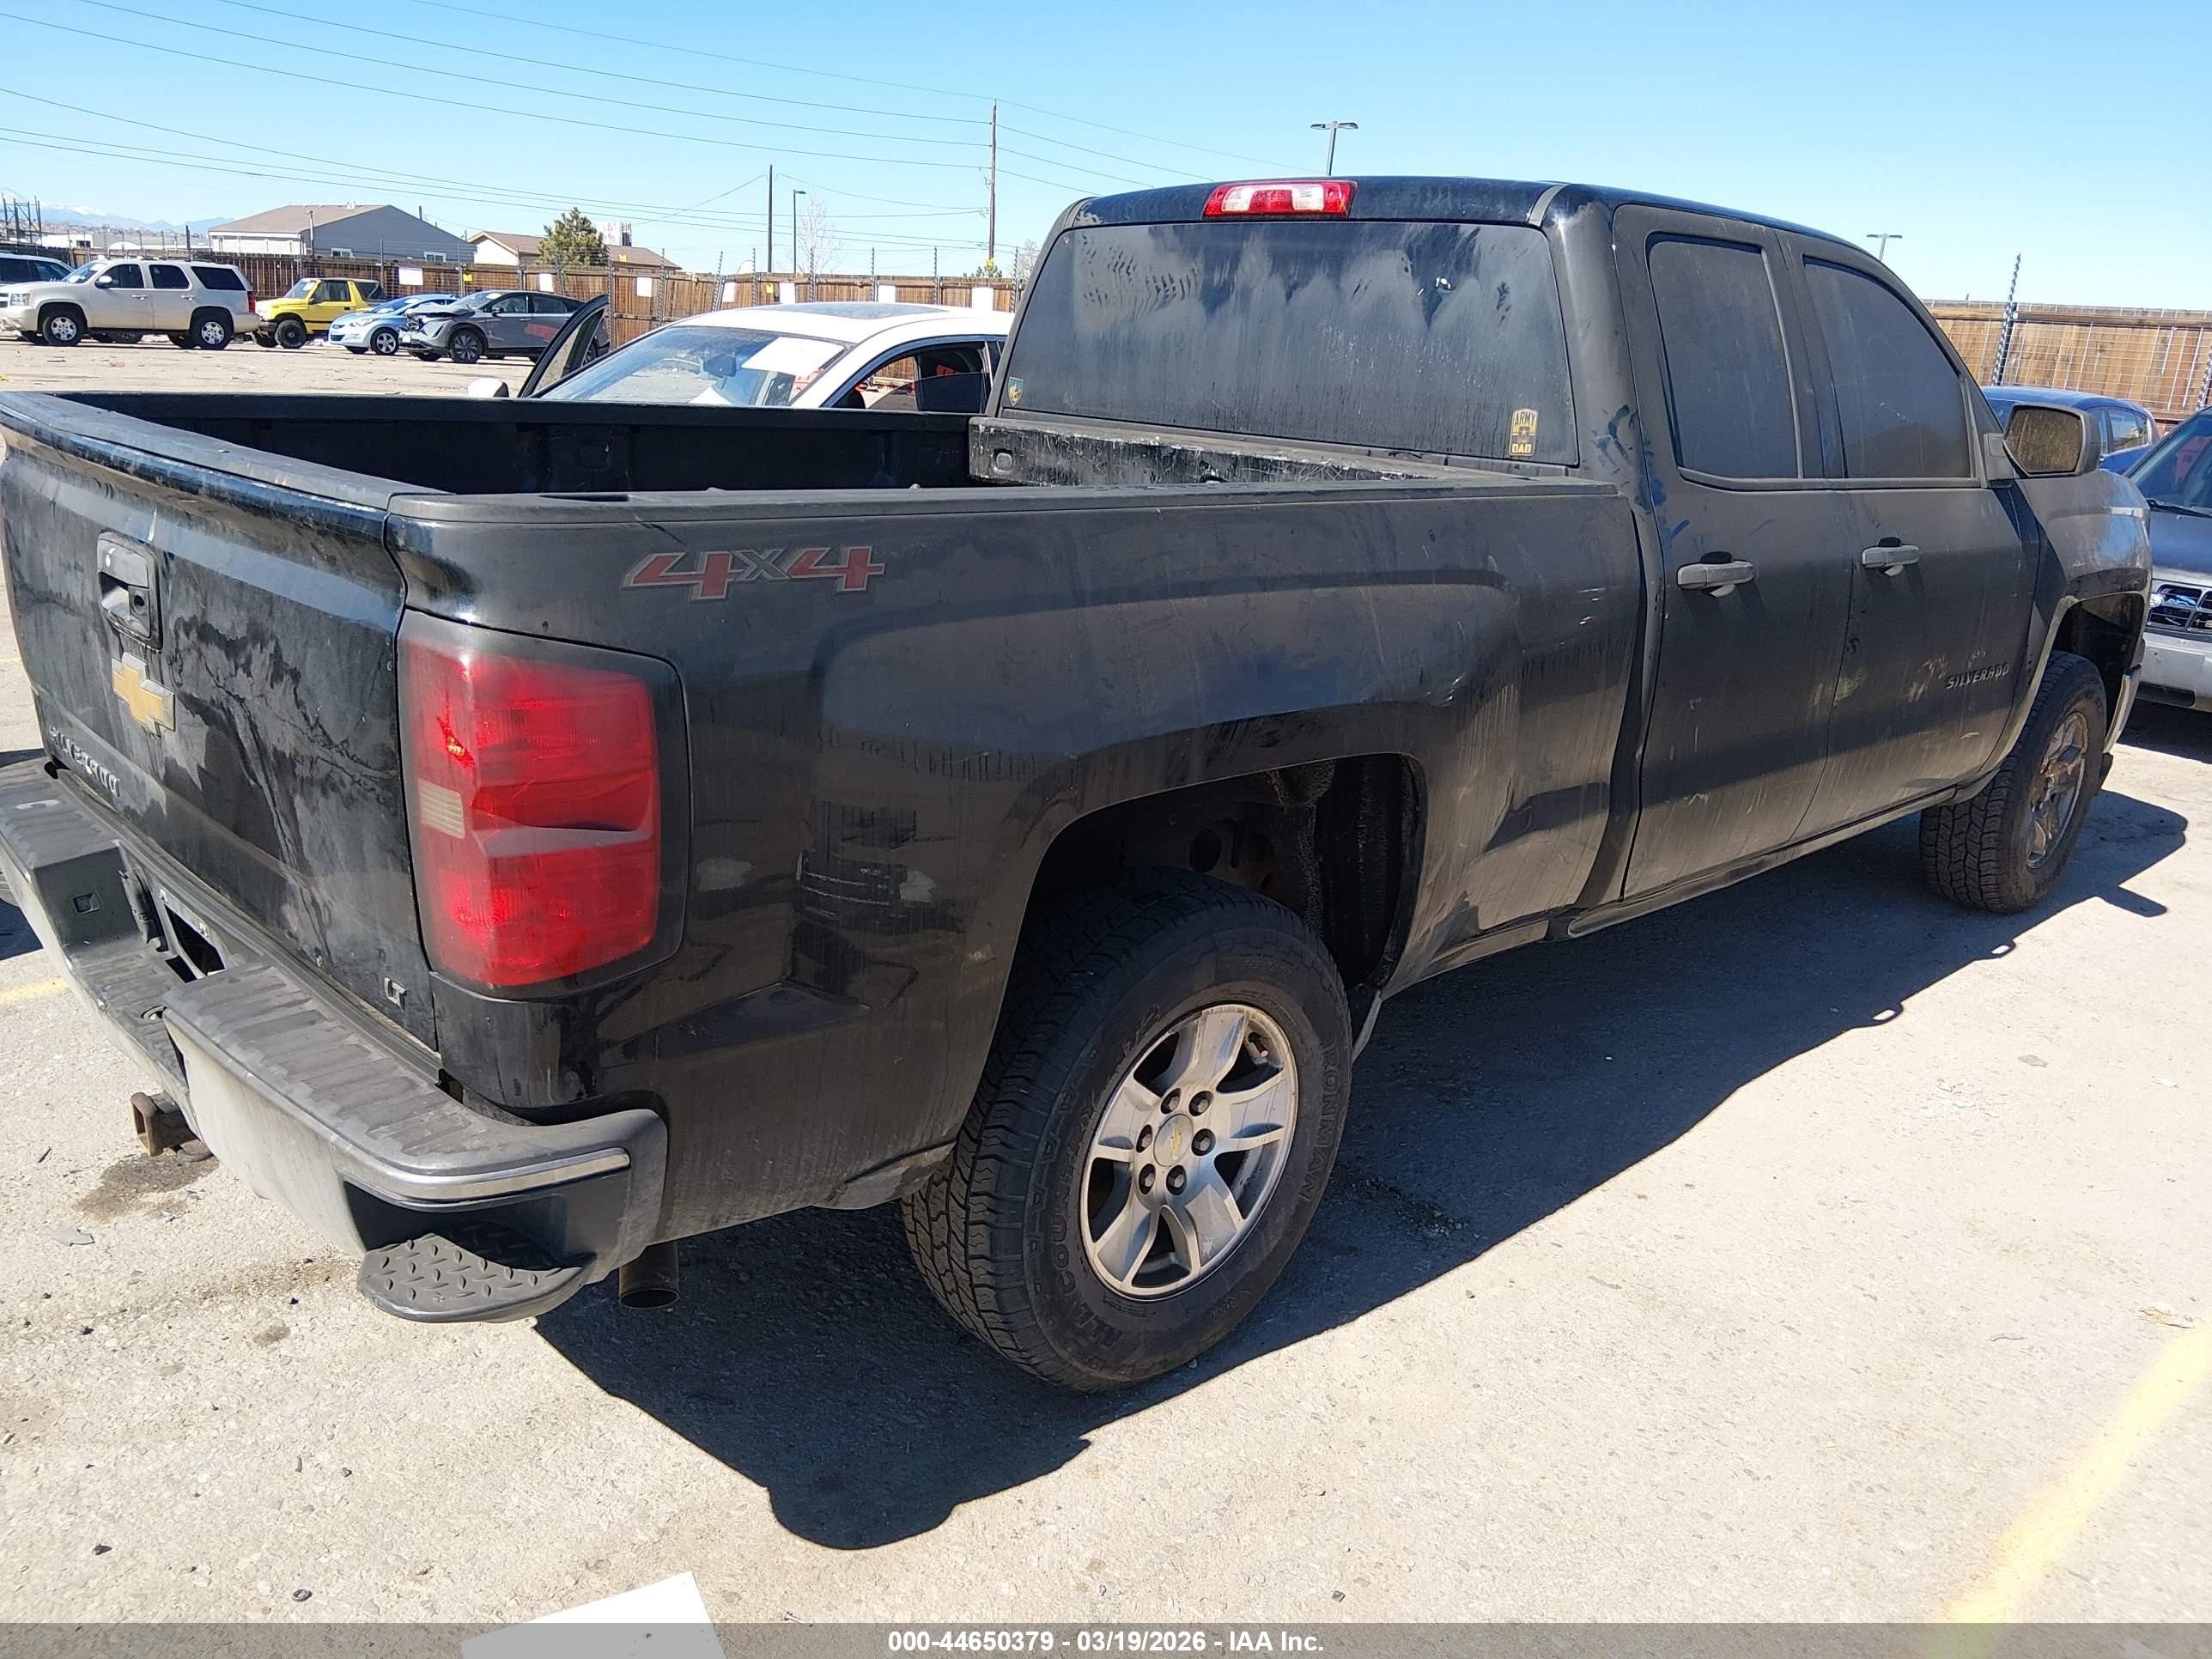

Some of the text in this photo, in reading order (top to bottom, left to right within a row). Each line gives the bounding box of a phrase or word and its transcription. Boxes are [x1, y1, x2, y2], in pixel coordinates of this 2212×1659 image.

[1513, 412, 1536, 427] ARMY
[1511, 443, 1532, 453] DAD
[1944, 662, 2010, 690] SILVERADO
[384, 976, 406, 1008] LT
[1297, 1036, 1340, 1200] IRONMAN
